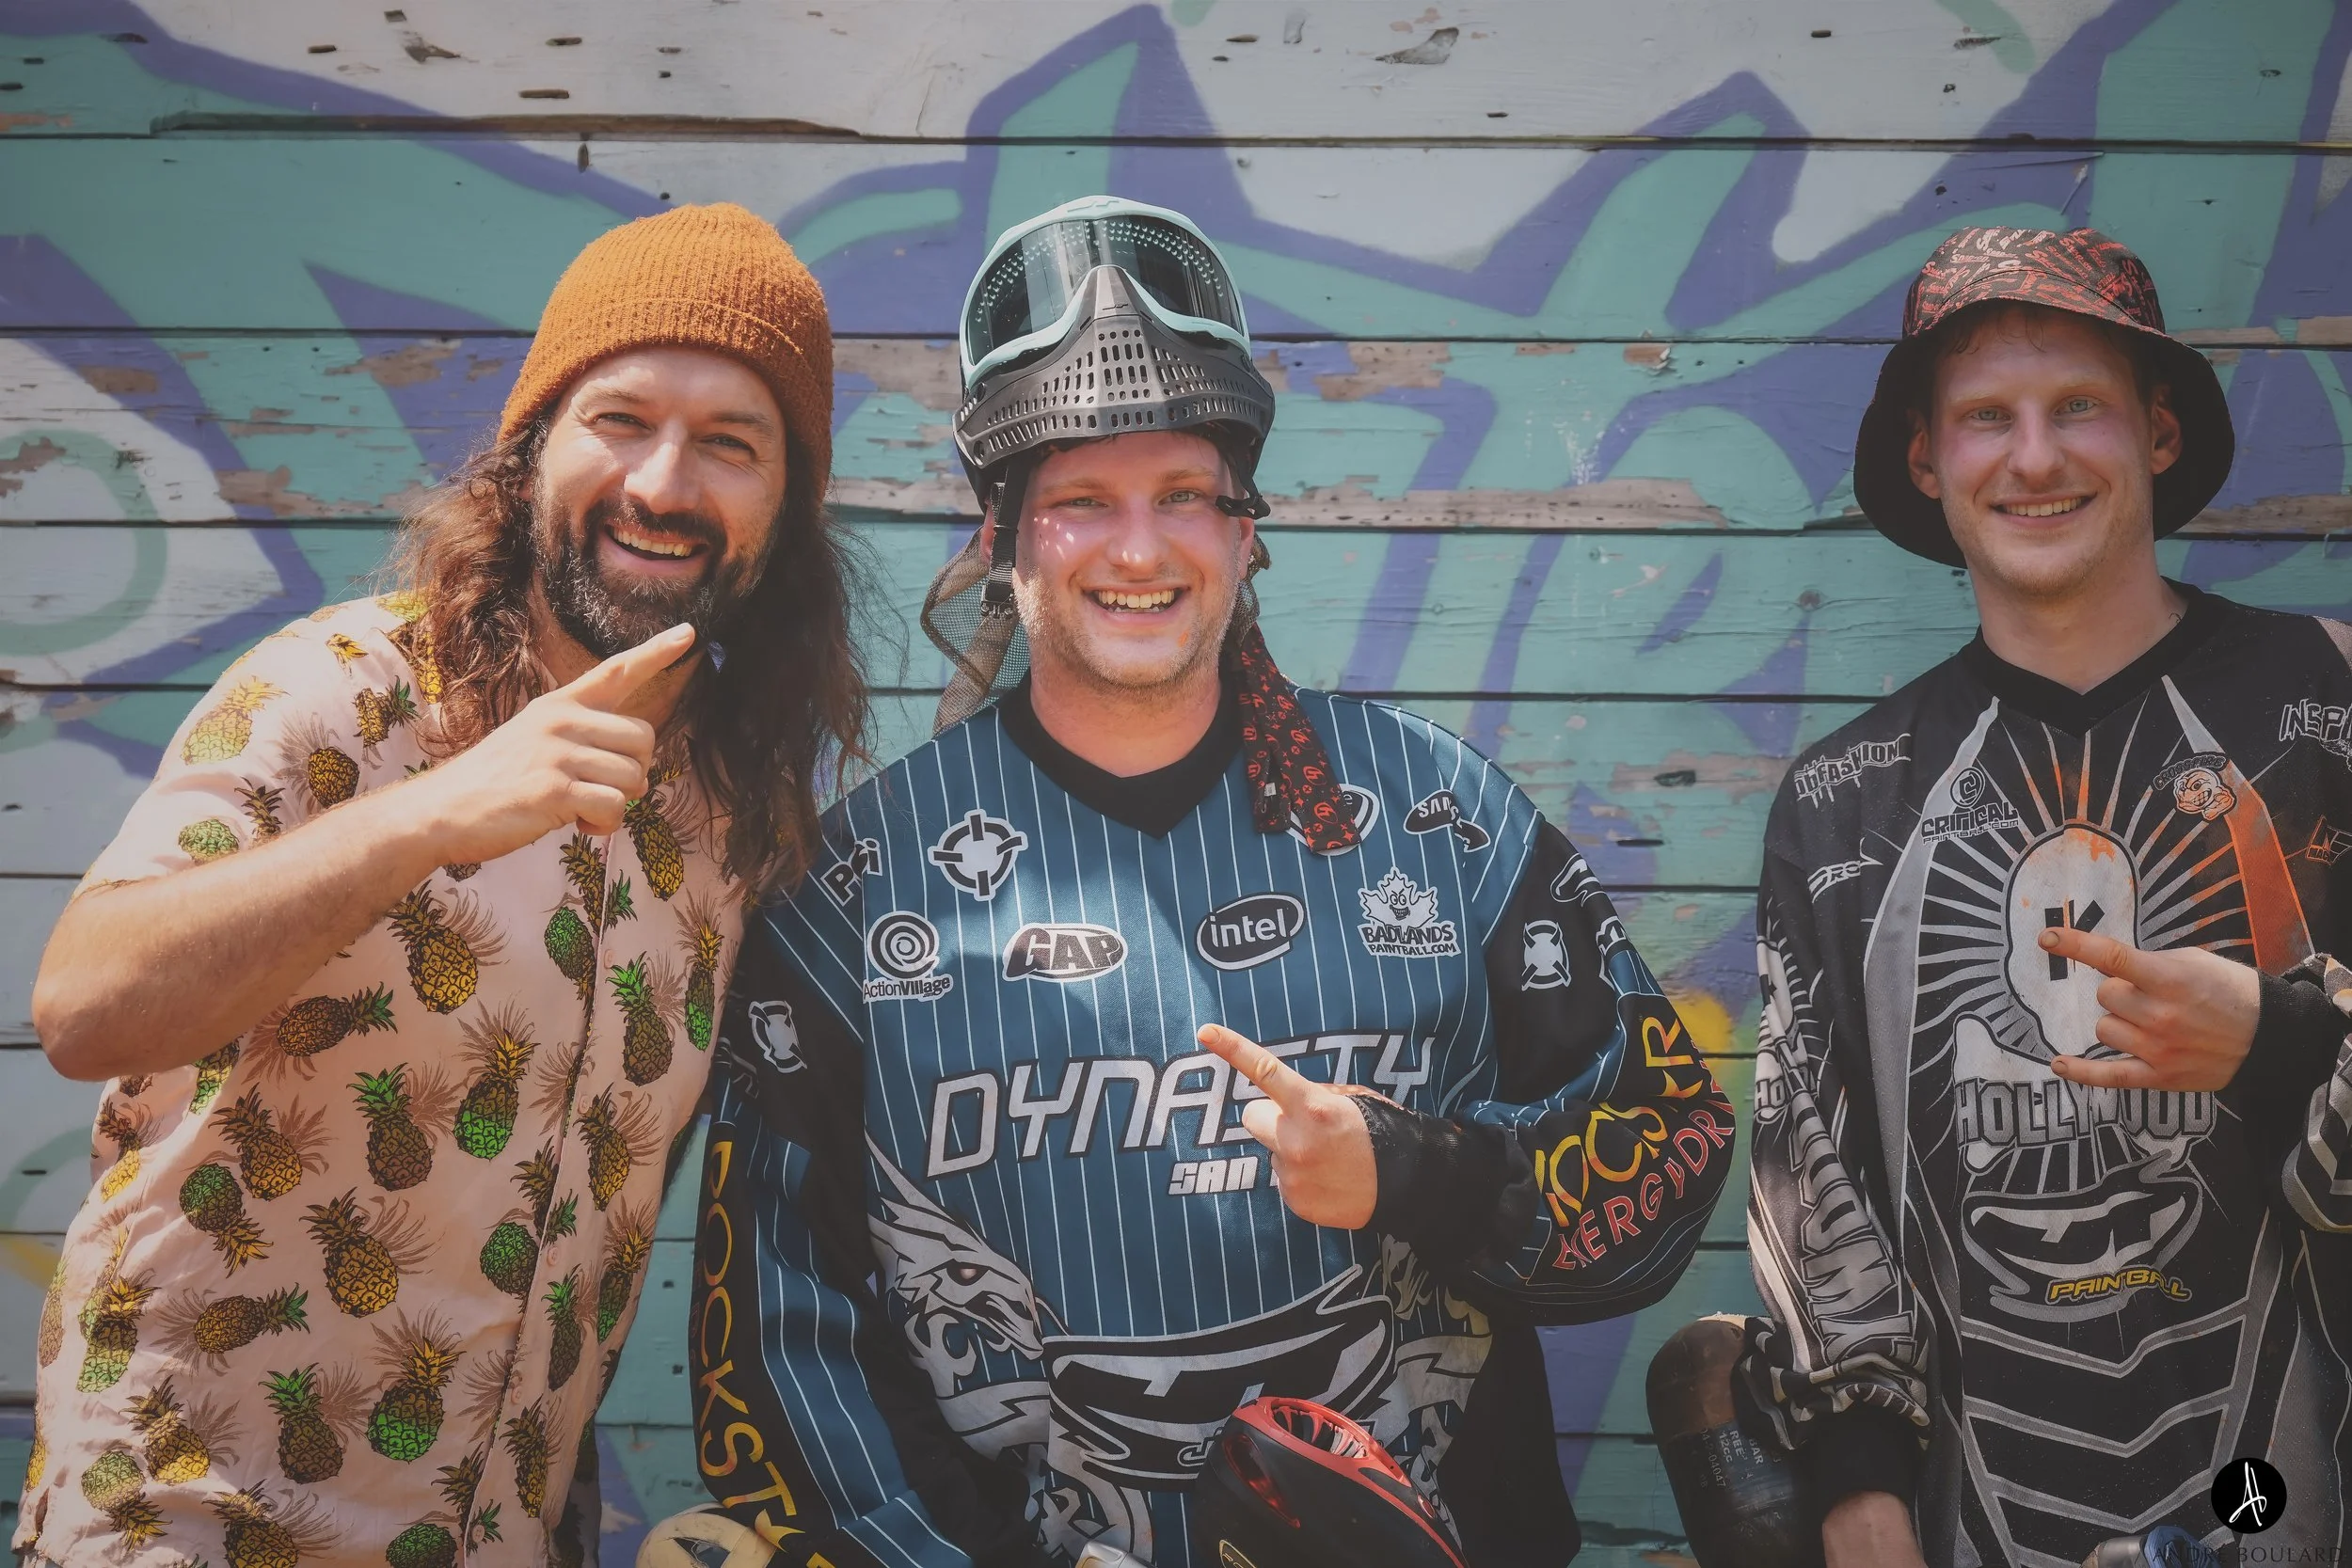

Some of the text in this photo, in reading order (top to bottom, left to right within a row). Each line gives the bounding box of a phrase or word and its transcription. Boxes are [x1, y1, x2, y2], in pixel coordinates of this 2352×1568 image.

[1921, 801, 2019, 837] CRITICAL
[1210, 908, 1287, 949] intel
[1361, 924, 1454, 945] BADLANDS
[1006, 927, 1125, 978] GAP
[1368, 943, 1457, 956] PAINTBALL.COM
[863, 976, 951, 1000] ActionVillage
[1955, 1076, 2216, 1147] HOLLYWOOD
[1168, 1156, 1258, 1196] SAN
[2050, 1269, 2187, 1300] PAINBAL
